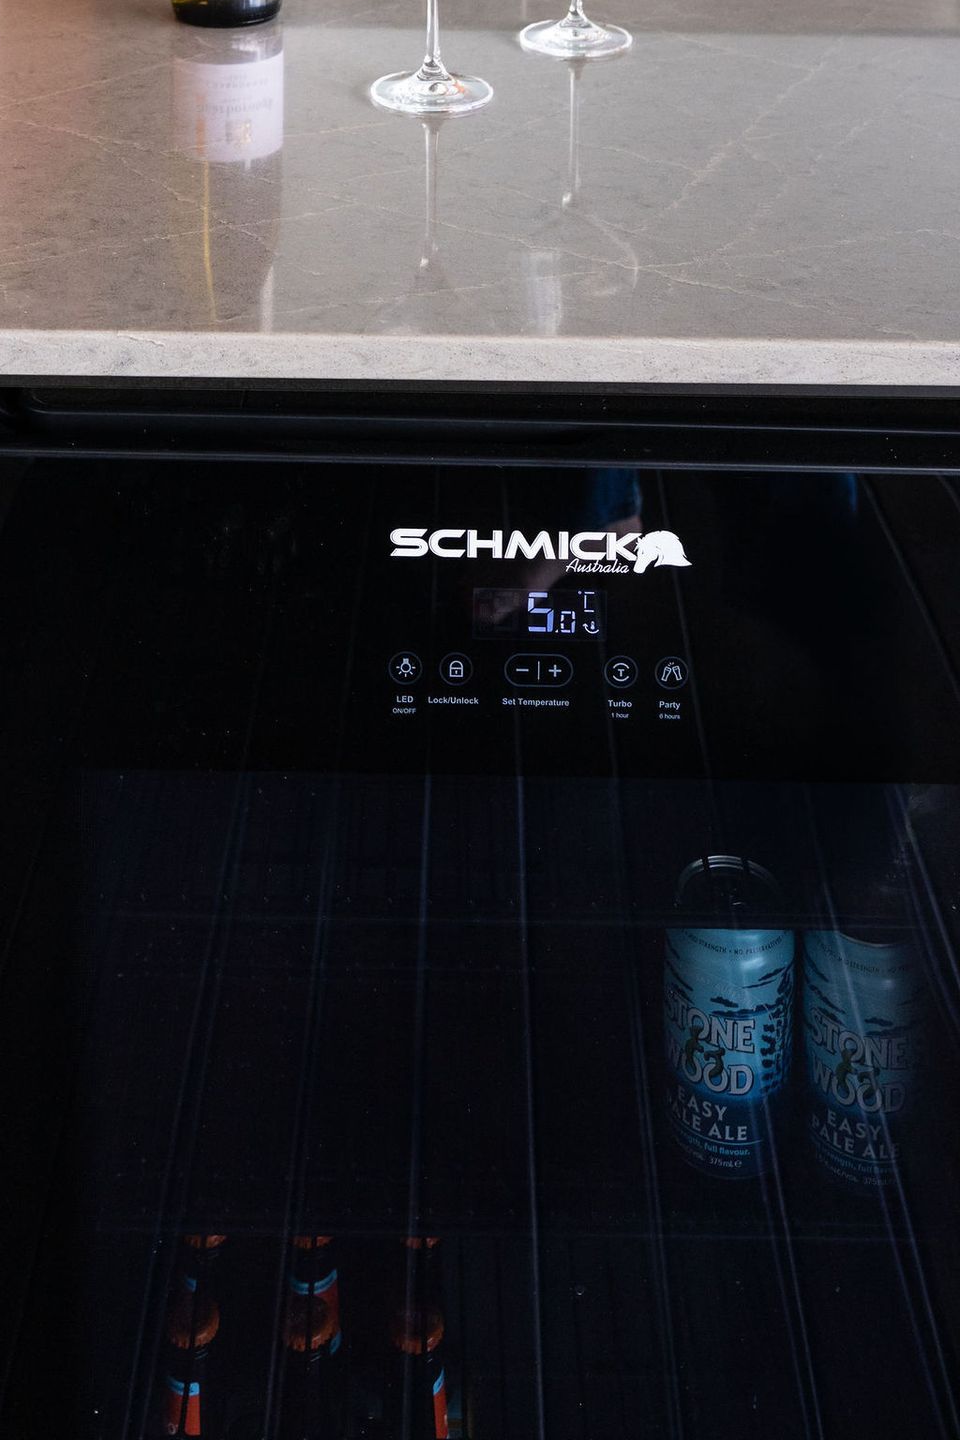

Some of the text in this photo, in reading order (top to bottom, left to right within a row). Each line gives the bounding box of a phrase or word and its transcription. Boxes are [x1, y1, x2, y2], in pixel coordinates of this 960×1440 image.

[390, 528, 642, 561] SCHMICK
[566, 559, 630, 574] Australia
[396, 695, 414, 703] LED
[428, 696, 479, 705] Lock/Unlock
[502, 697, 570, 707] Set Temperature
[607, 699, 633, 708] Turbo
[658, 700, 681, 710] Party
[664, 998, 755, 1054] STONE
[810, 1007, 907, 1070] STONE
[678, 1084, 727, 1122] EASY
[707, 1122, 748, 1140] ALE
[827, 1107, 881, 1141] EASY
[704, 1142, 718, 1153] full
